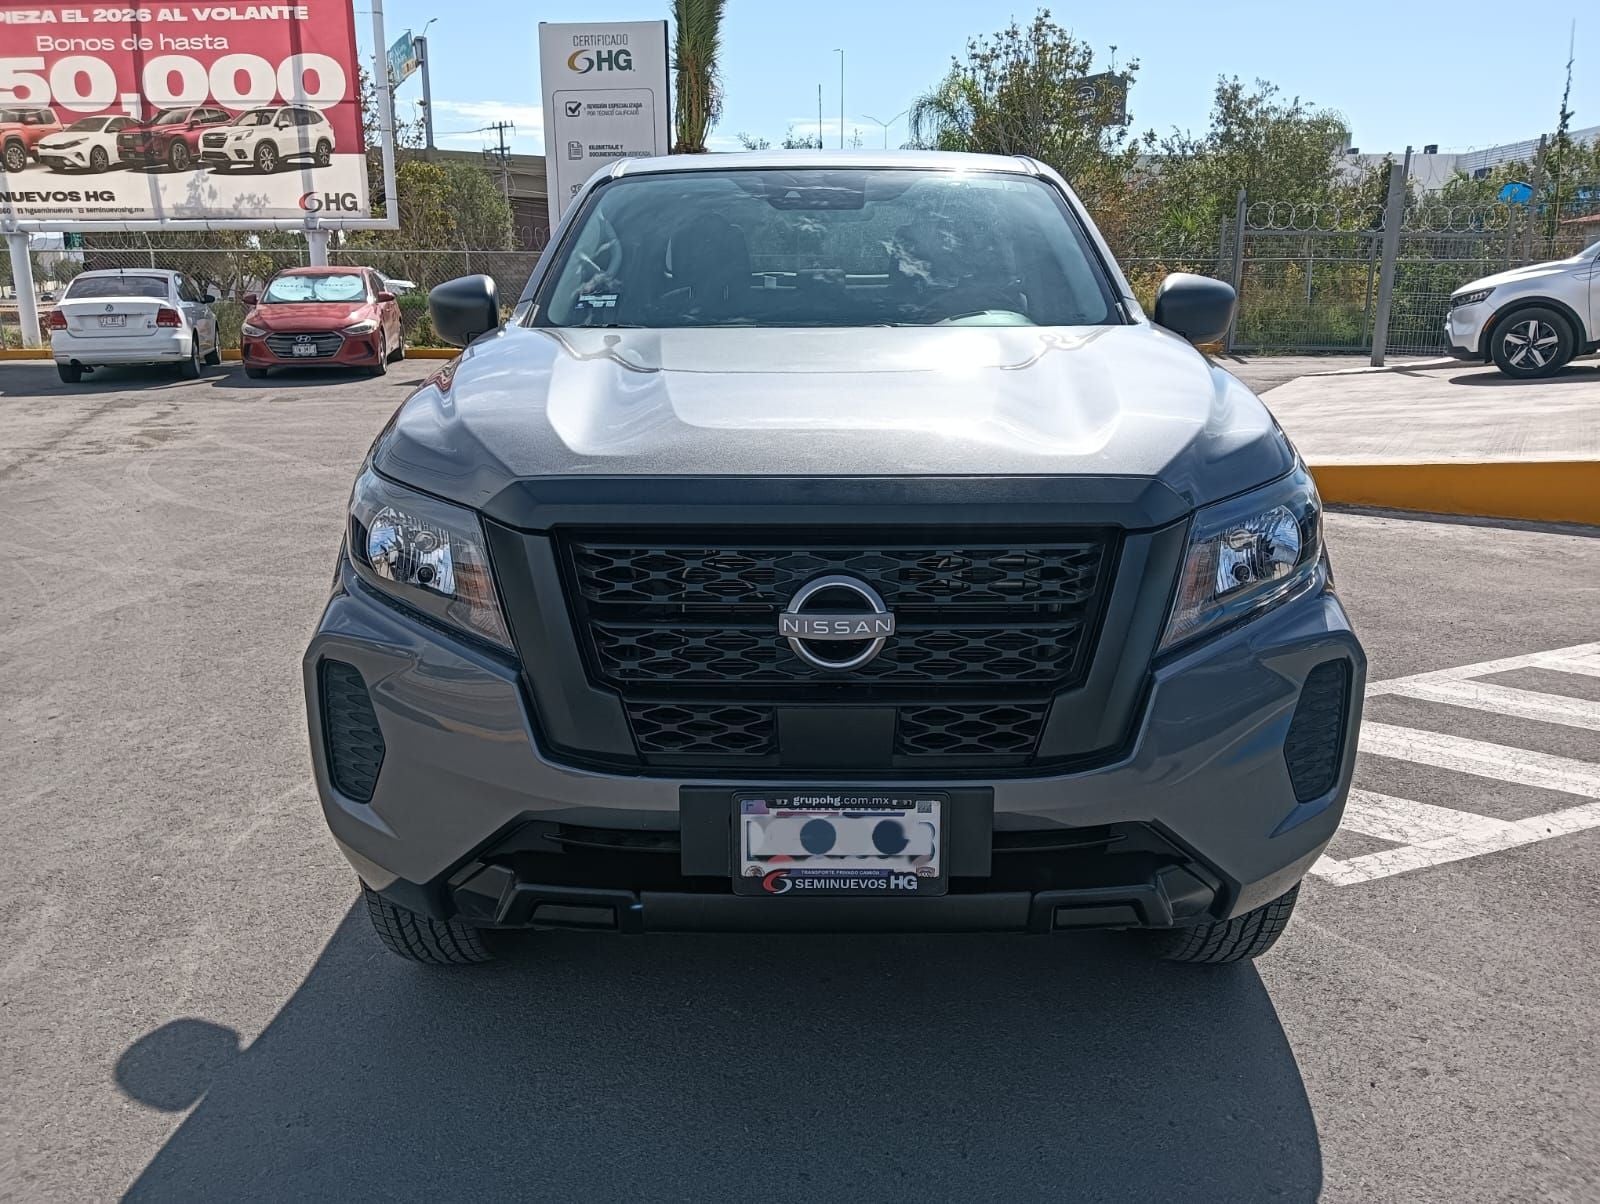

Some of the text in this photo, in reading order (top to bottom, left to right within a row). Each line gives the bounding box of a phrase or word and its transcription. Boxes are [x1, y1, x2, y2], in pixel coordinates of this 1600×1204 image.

[61, 9, 89, 23] EL
[92, 8, 152, 22] 2026
[157, 8, 188, 22] AL
[192, 6, 308, 21] VOLANTE
[36, 33, 229, 52] Bonos de hasta
[572, 33, 628, 47] CERTIFICADO
[595, 49, 633, 71] HG
[0, 53, 346, 121] 50,000
[0, 190, 116, 203] NUEVOS HG
[324, 192, 358, 212] HG
[783, 618, 892, 635] NISSAN
[792, 795, 890, 807] grupohg.com.mx
[795, 875, 919, 890] SEMINUEVOS HG
